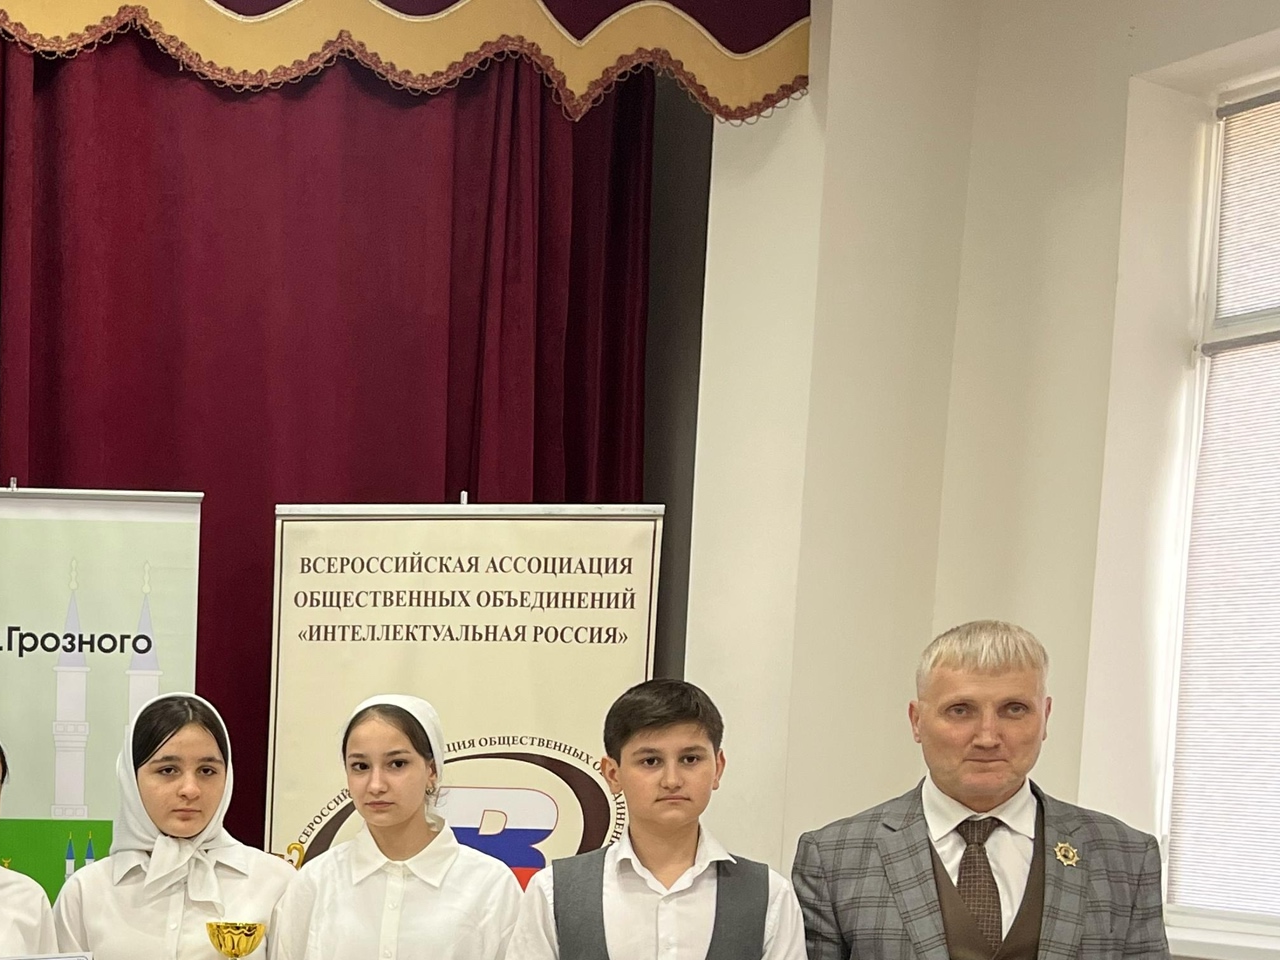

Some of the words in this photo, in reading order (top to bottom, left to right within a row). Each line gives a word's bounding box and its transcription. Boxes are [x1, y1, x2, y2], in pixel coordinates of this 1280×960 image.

[299, 552, 480, 574] ВСЕРОССИЙСКАЯ
[485, 556, 633, 578] АССОЦИАЦИЯ
[293, 590, 471, 611] ОБЩЕСТВЕННЫХ
[476, 588, 636, 613] ОБЪЕДИНЕНИЙ
[298, 624, 527, 642] «ИНТЕЛЛЕКТУАЛЬНАЯ
[532, 626, 629, 644] РОССИЯ»
[478, 735, 593, 765] ОБЩЕСТВЕННЫХ
[298, 788, 350, 845] СЕРОССИЙ
